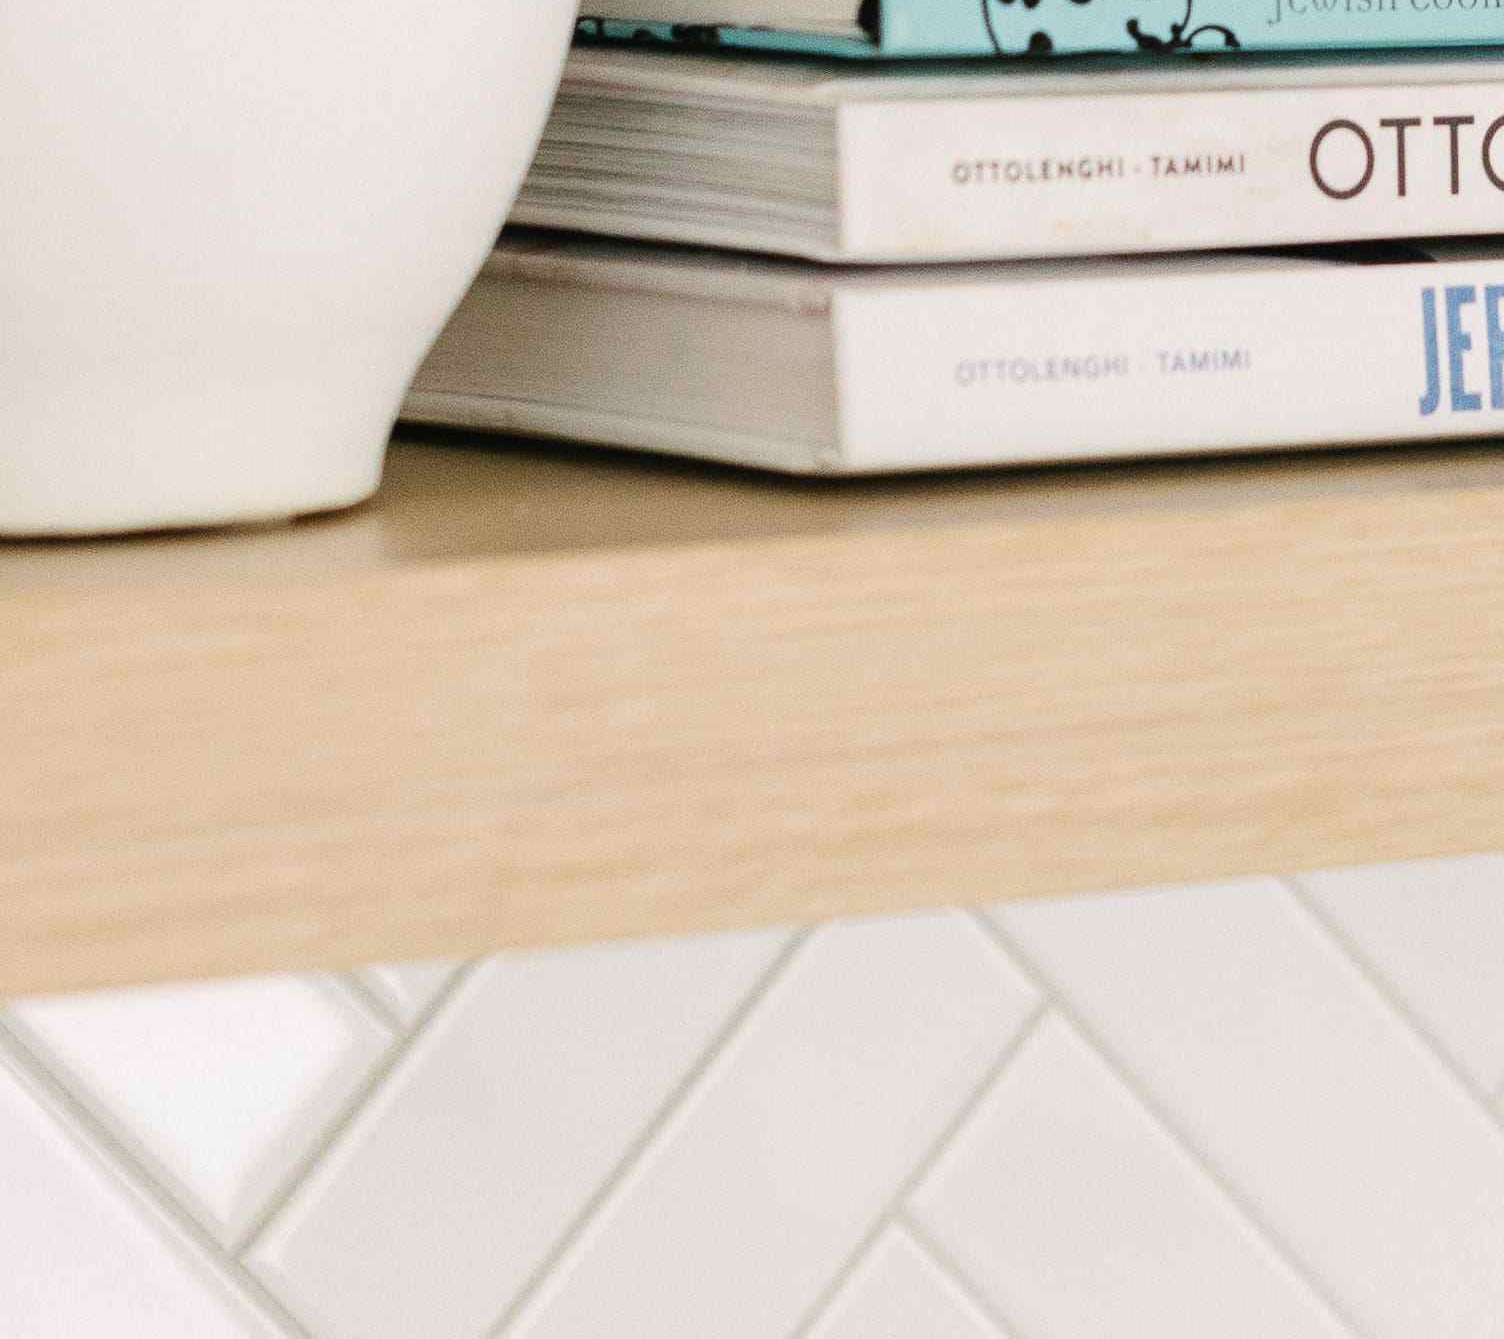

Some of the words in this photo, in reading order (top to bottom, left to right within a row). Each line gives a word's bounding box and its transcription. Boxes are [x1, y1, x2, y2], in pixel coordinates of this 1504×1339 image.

[951, 156, 1126, 186] OTTOLENGHI
[1151, 153, 1248, 179] TAMIMI
[954, 356, 1130, 389] OTTOLENGHI
[1156, 349, 1252, 376] TAMIMI
